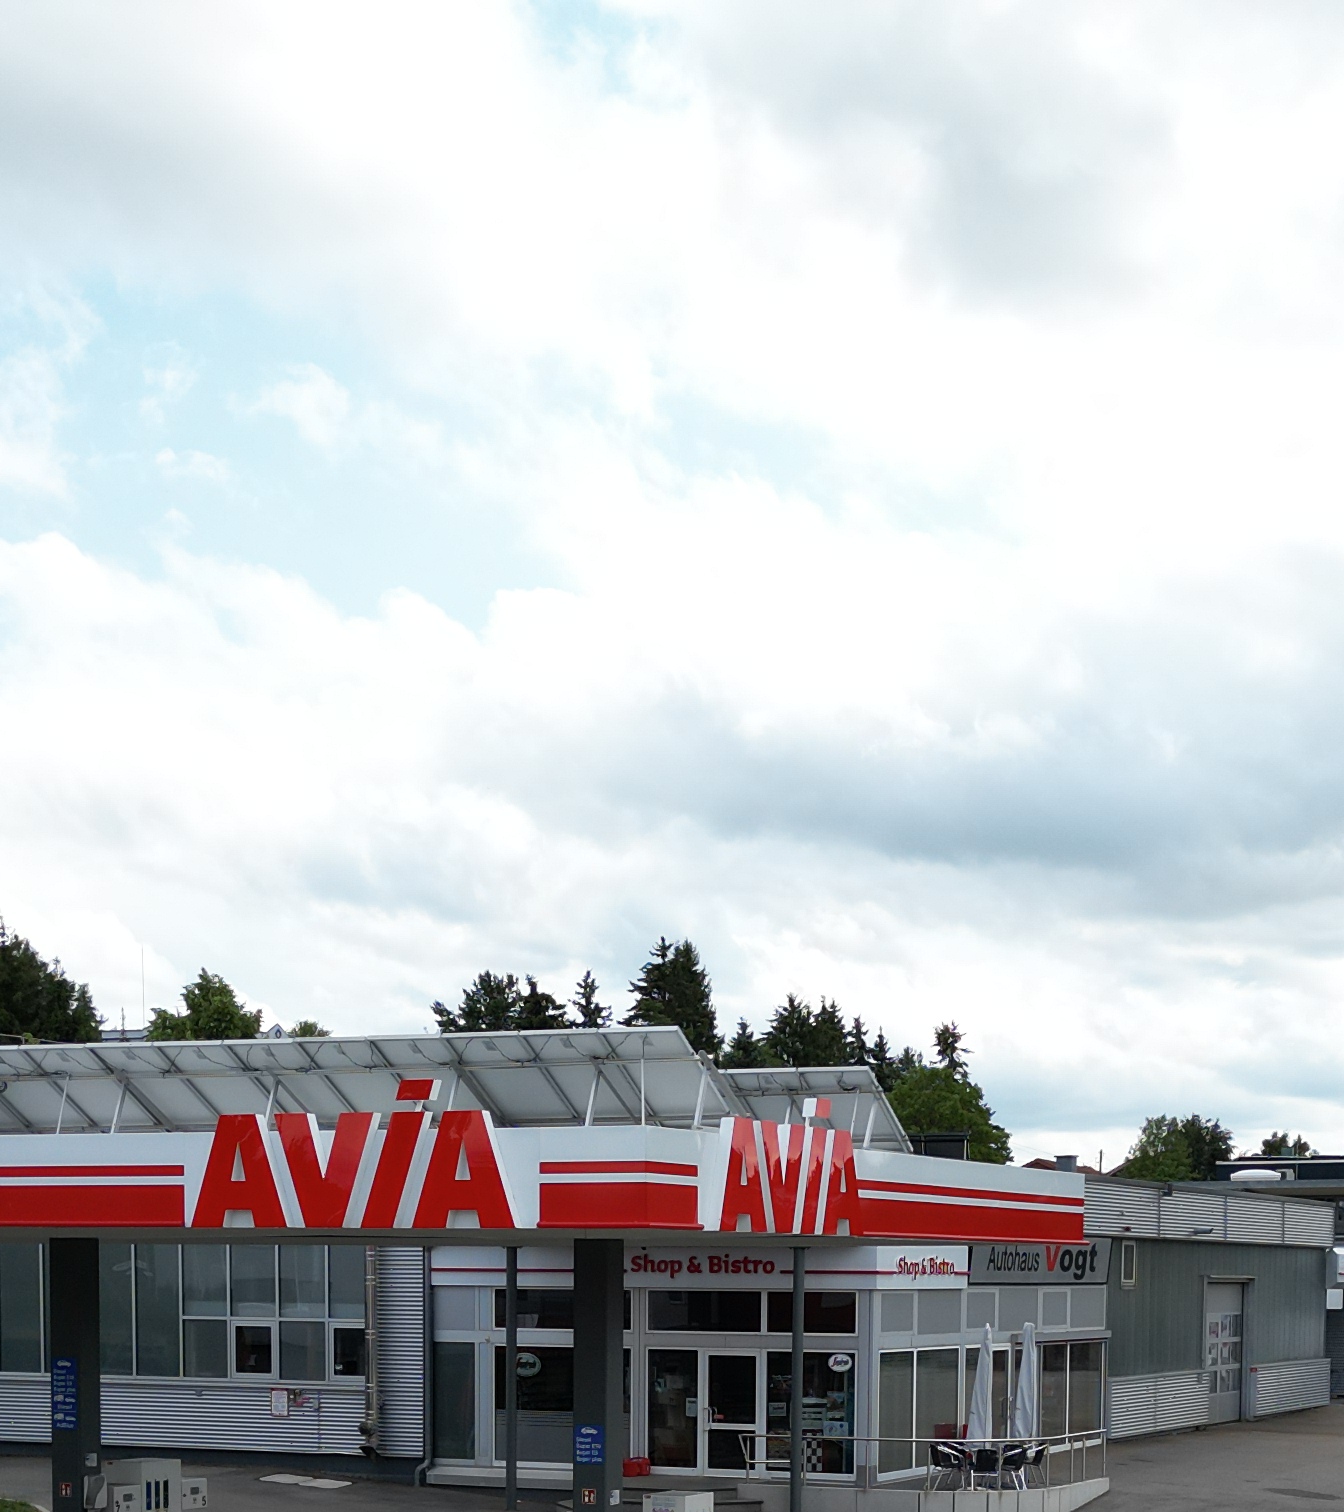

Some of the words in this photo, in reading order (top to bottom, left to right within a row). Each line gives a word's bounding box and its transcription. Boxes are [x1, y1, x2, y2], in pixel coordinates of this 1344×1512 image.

[192, 1078, 516, 1230] AVIA
[720, 1097, 863, 1237] AVIA
[630, 1255, 683, 1278] Shop
[686, 1257, 703, 1274] &
[707, 1255, 776, 1275] Bistro
[896, 1256, 920, 1280] Shop
[928, 1255, 956, 1277] Bistro
[986, 1245, 1040, 1273] Autohaus
[1045, 1245, 1099, 1281] Vogt
